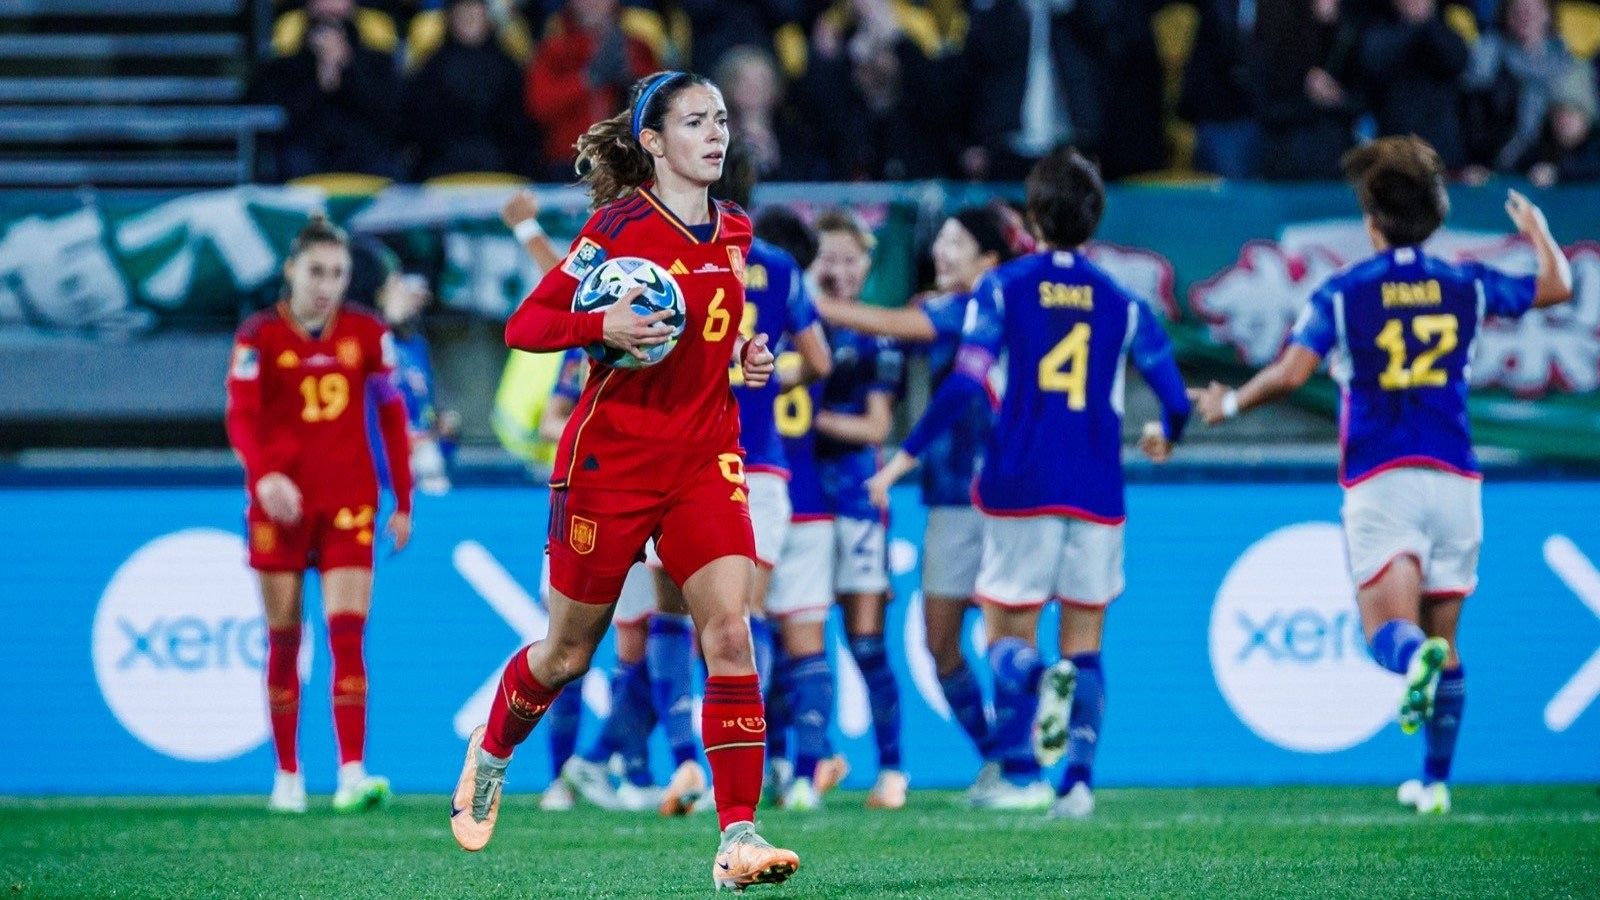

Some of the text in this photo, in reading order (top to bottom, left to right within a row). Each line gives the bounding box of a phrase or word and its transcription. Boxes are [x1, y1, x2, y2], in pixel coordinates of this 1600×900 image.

[702, 287, 731, 341] 6
[1037, 321, 1092, 412] 4
[1374, 313, 1459, 390] 12
[300, 372, 350, 424] 19
[1234, 609, 1371, 665] xer
